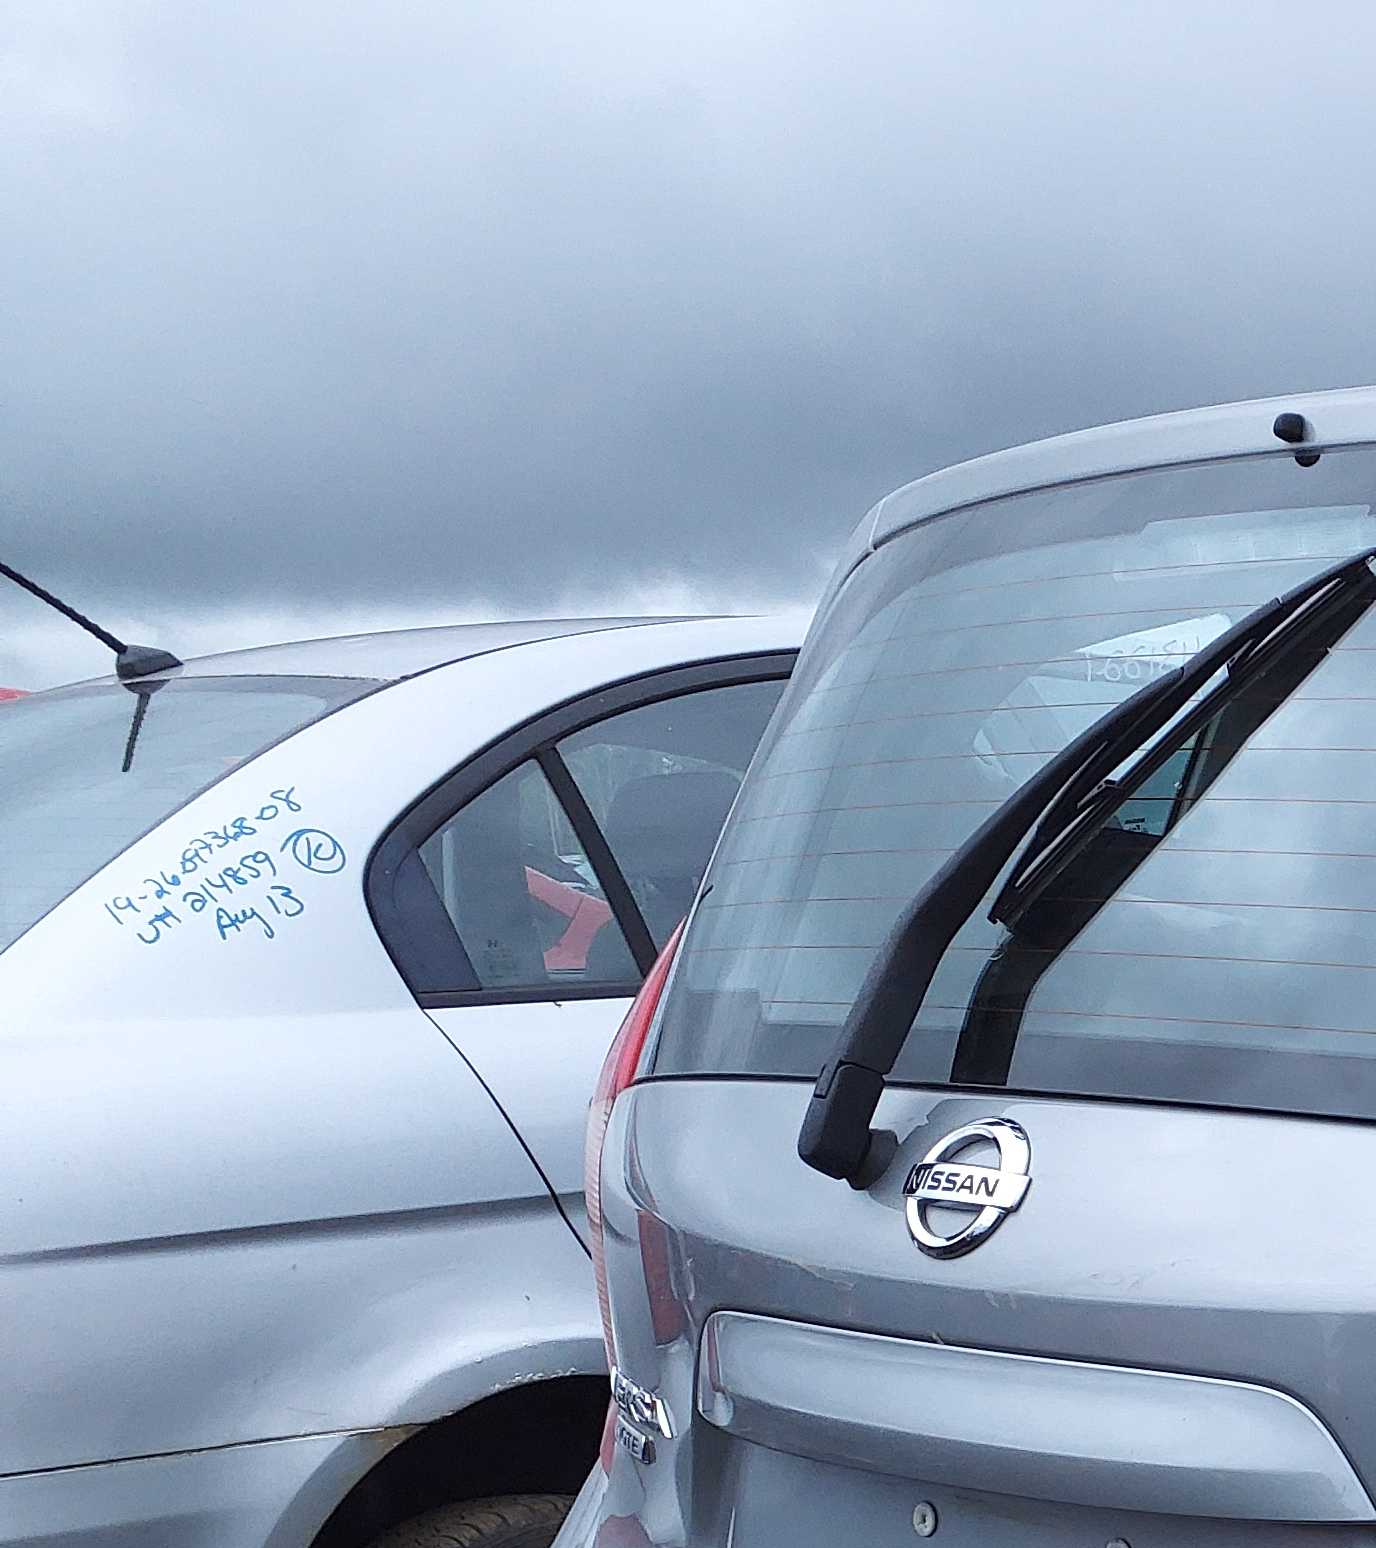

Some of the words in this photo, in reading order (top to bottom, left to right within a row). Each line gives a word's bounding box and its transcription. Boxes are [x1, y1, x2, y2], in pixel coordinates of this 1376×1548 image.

[183, 850, 277, 912] 214859
[215, 905, 276, 940] Aug
[266, 884, 305, 918] 13
[907, 1167, 1000, 1198] NISSAN
